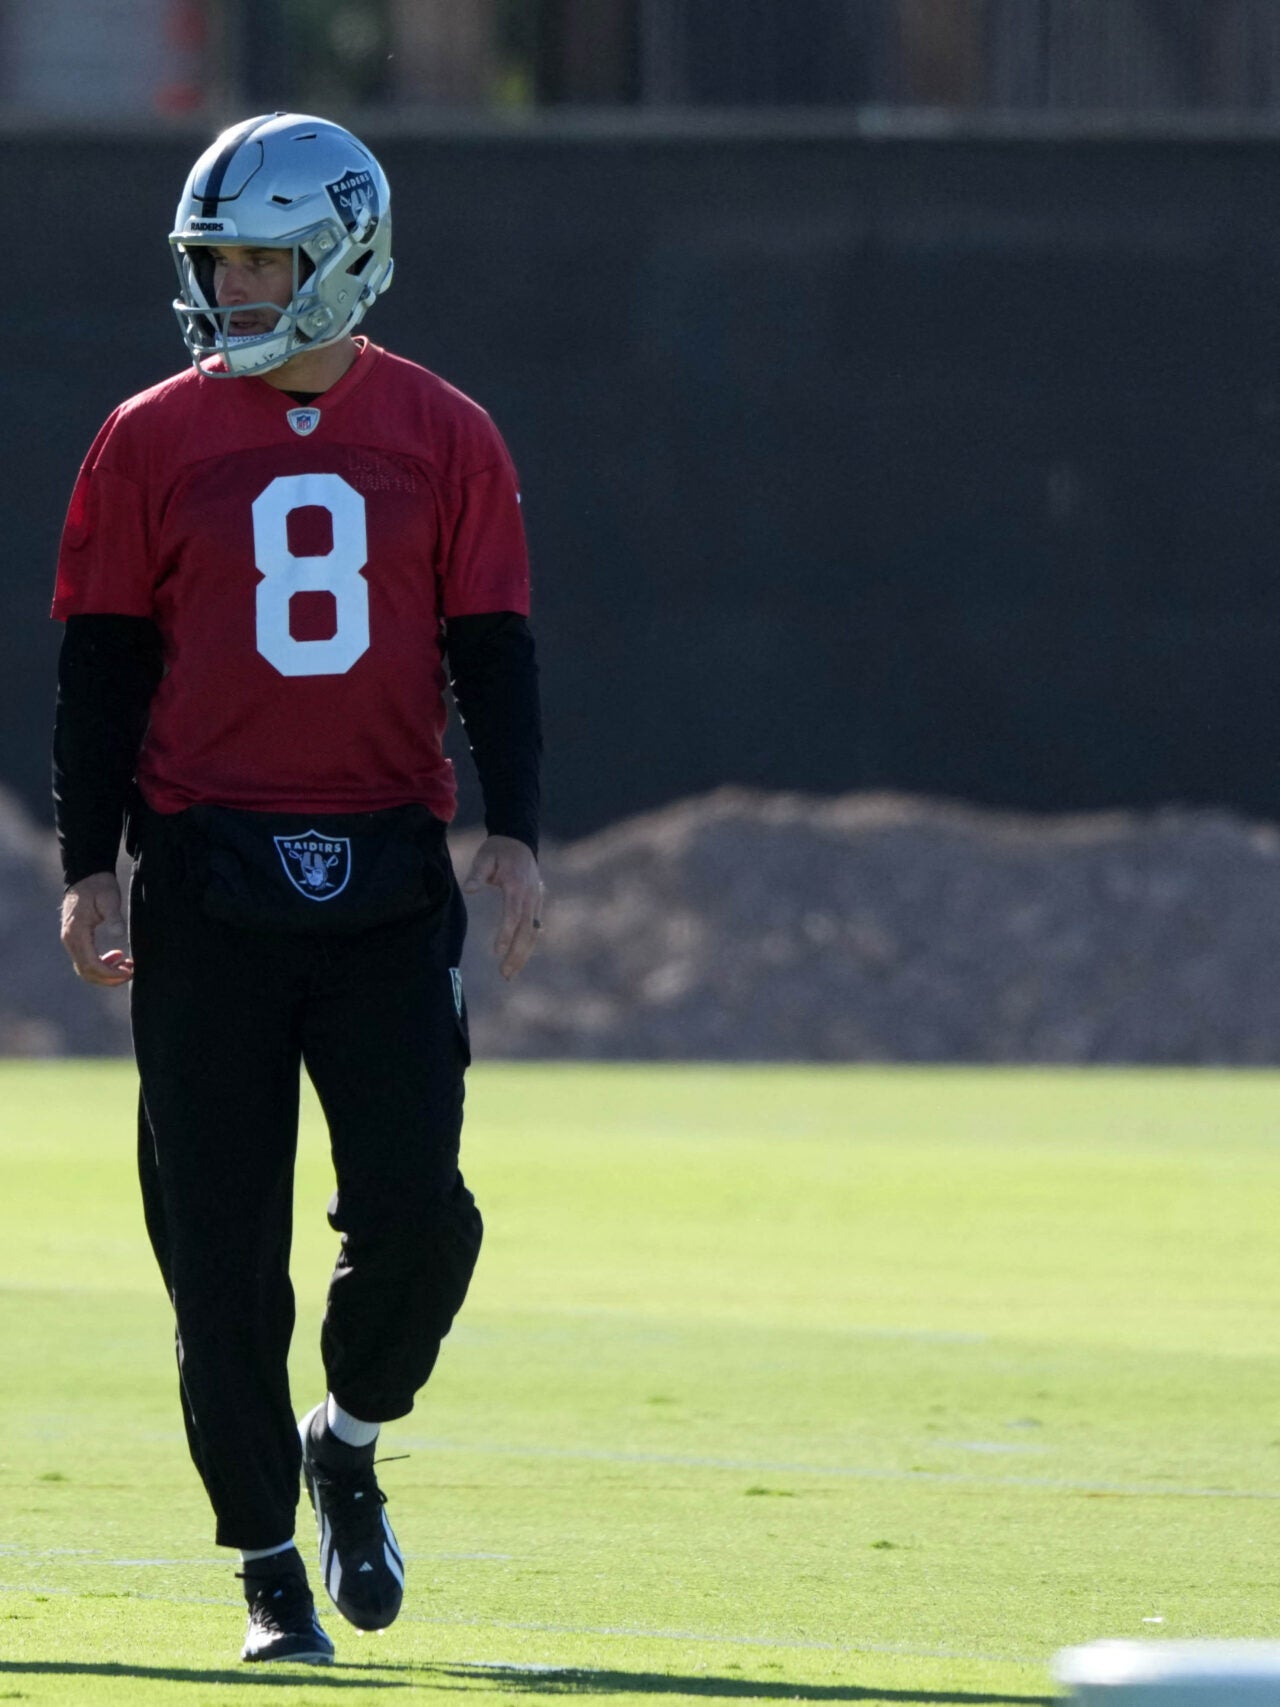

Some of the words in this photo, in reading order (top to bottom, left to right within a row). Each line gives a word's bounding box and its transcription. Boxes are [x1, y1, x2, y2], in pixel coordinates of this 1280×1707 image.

[332, 172, 371, 194] RAIDERS
[190, 222, 224, 231] RAIDERS
[252, 473, 371, 677] 8
[283, 841, 342, 853] RAIDERS
